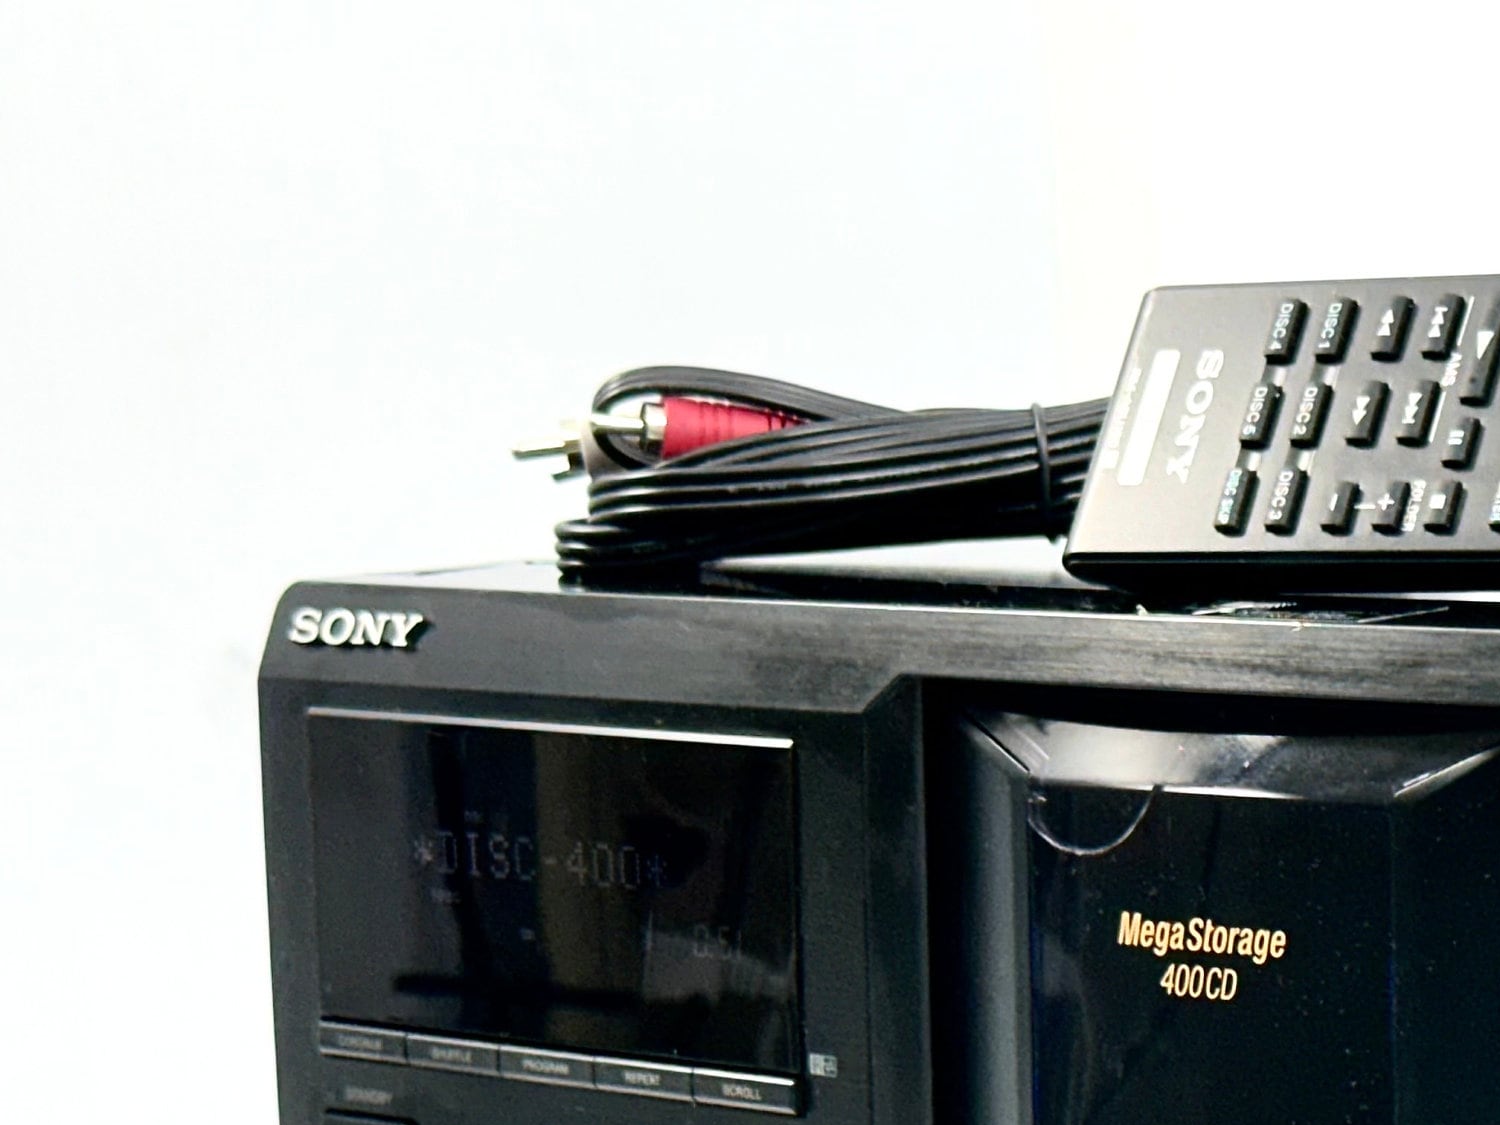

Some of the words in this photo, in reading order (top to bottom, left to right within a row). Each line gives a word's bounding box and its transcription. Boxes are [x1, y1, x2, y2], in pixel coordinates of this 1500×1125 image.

[1273, 303, 1294, 339] DISC
[1321, 303, 1342, 339] DISC
[1166, 350, 1225, 484] SONY
[1246, 387, 1268, 423] DISC
[1296, 387, 1318, 423] DISC
[1271, 470, 1293, 508] DISC
[288, 606, 424, 648] SONY
